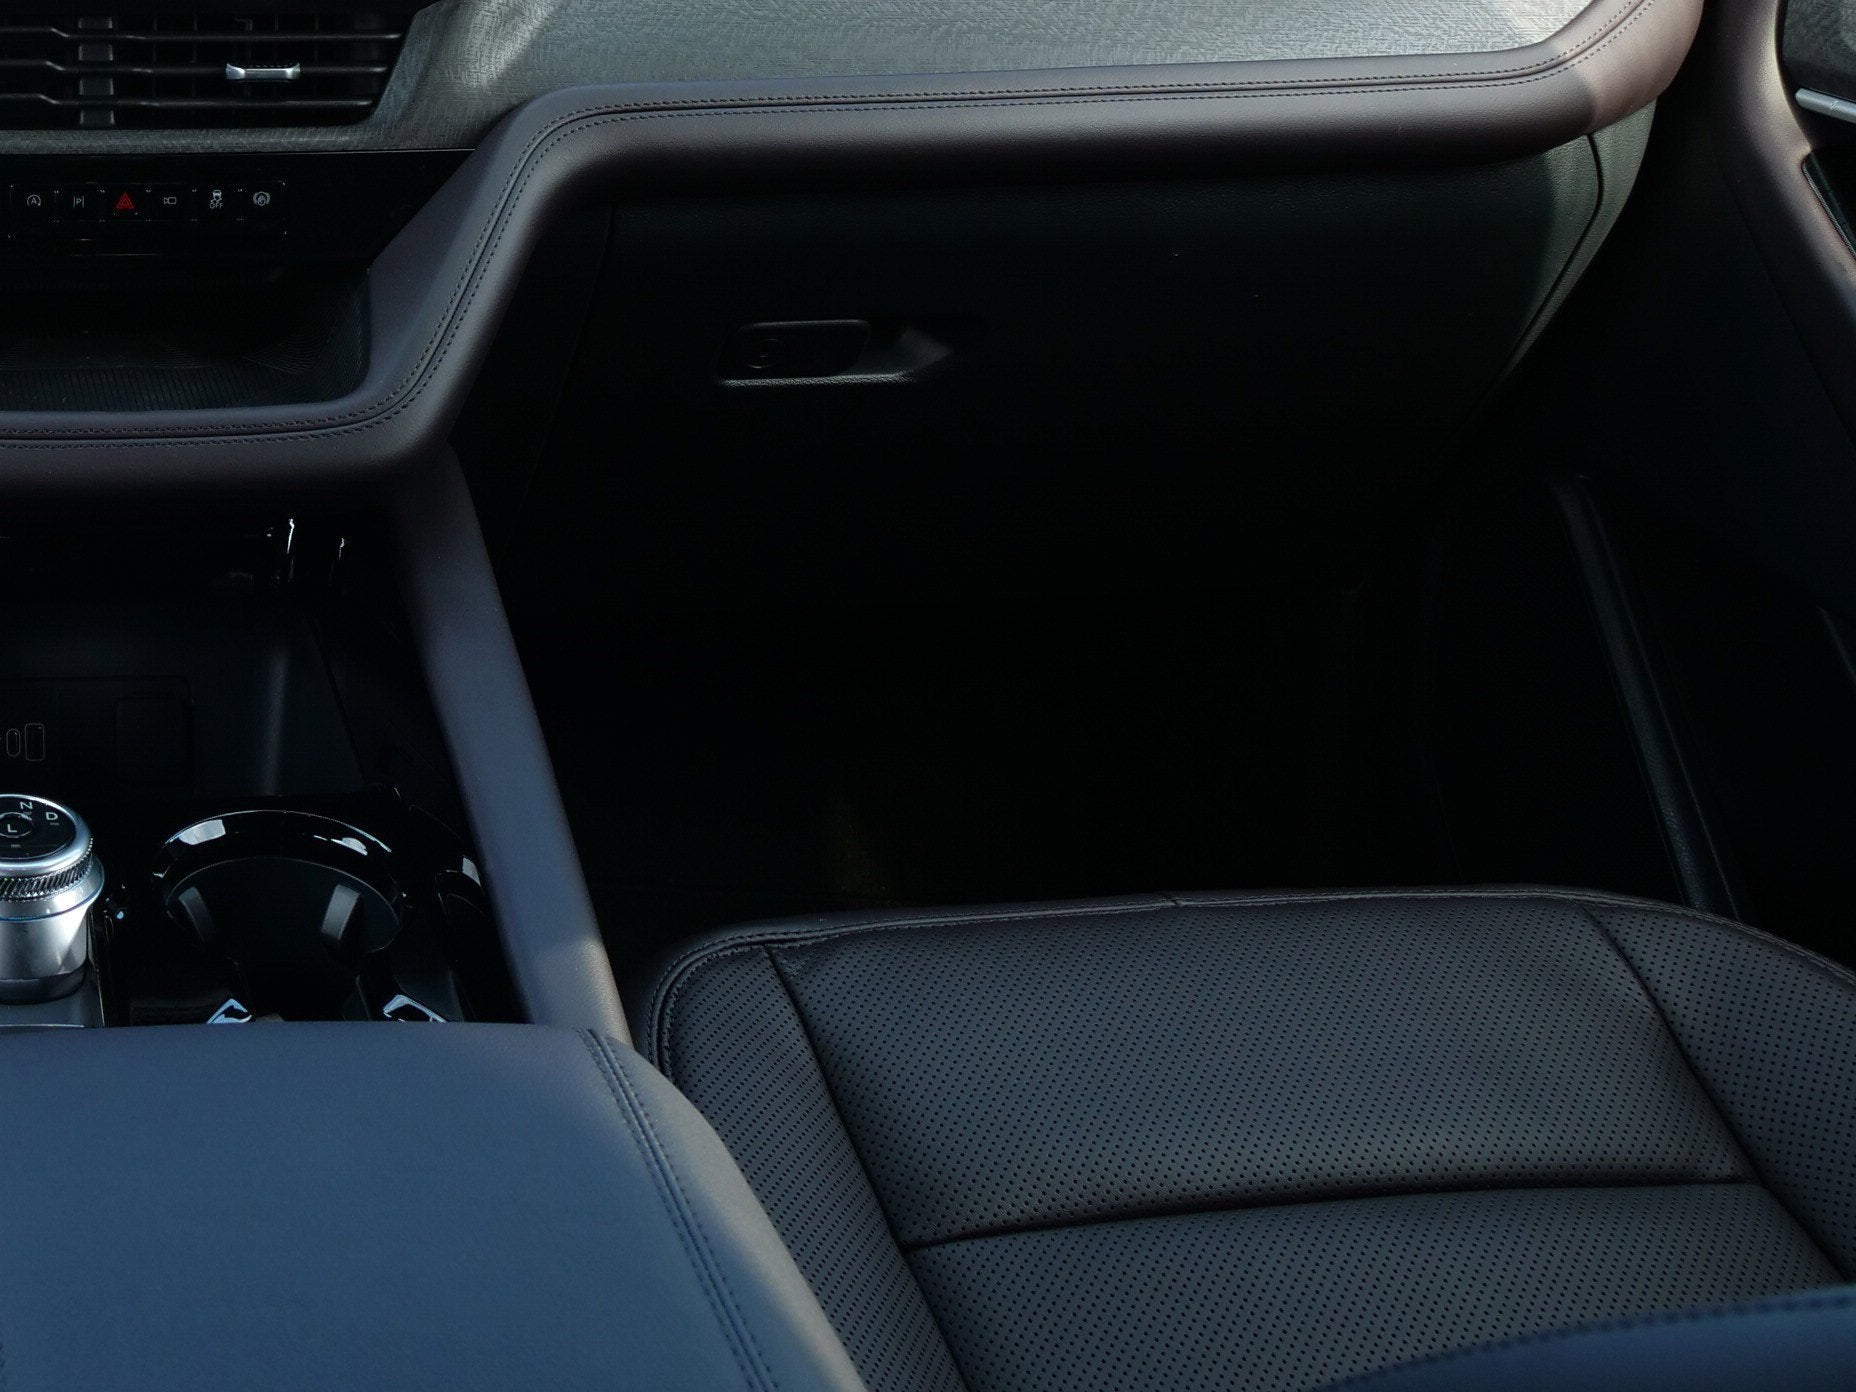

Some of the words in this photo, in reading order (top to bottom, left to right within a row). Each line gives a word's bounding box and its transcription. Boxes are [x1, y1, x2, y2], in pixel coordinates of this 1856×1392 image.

[20, 801, 33, 810] N
[45, 811, 58, 821] D
[7, 824, 17, 833] L
